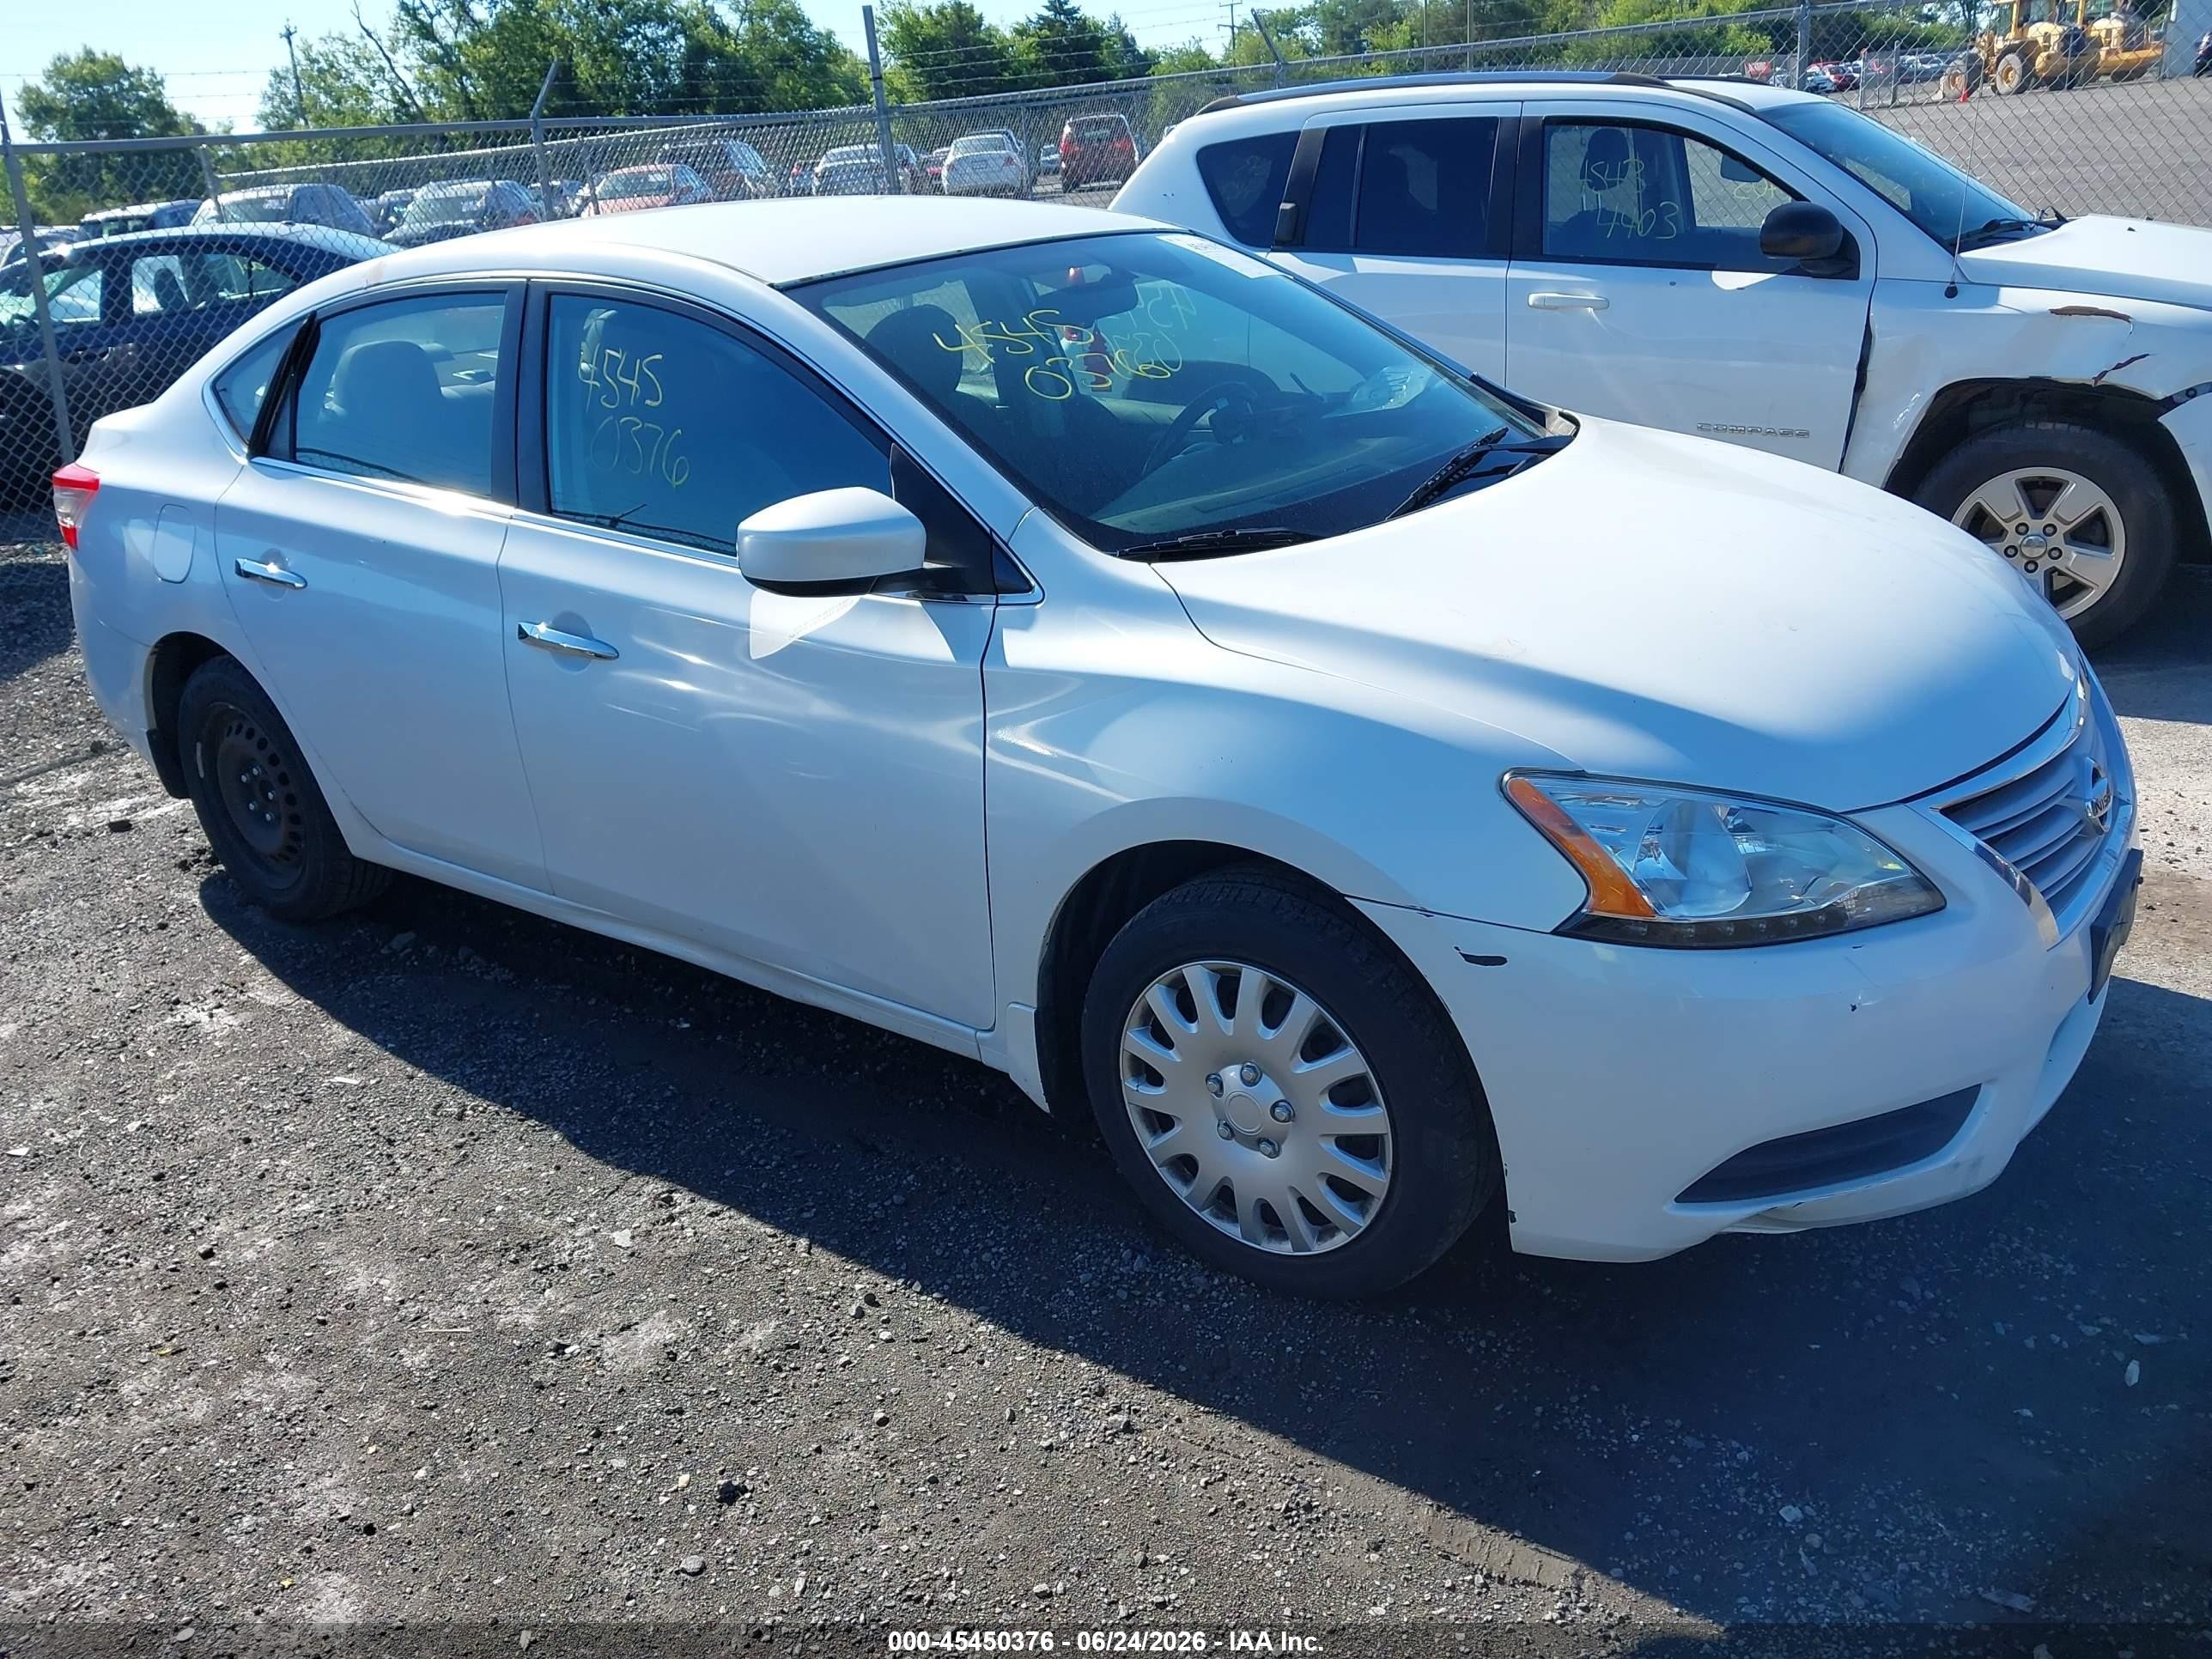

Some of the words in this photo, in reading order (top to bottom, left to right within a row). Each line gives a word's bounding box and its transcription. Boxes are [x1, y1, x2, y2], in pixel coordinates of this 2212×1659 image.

[933, 310, 1095, 363] 4545
[578, 343, 663, 412] 4545
[1024, 349, 1171, 399] 0376
[591, 416, 690, 488] 0376
[1696, 422, 1810, 439] COMPASS
